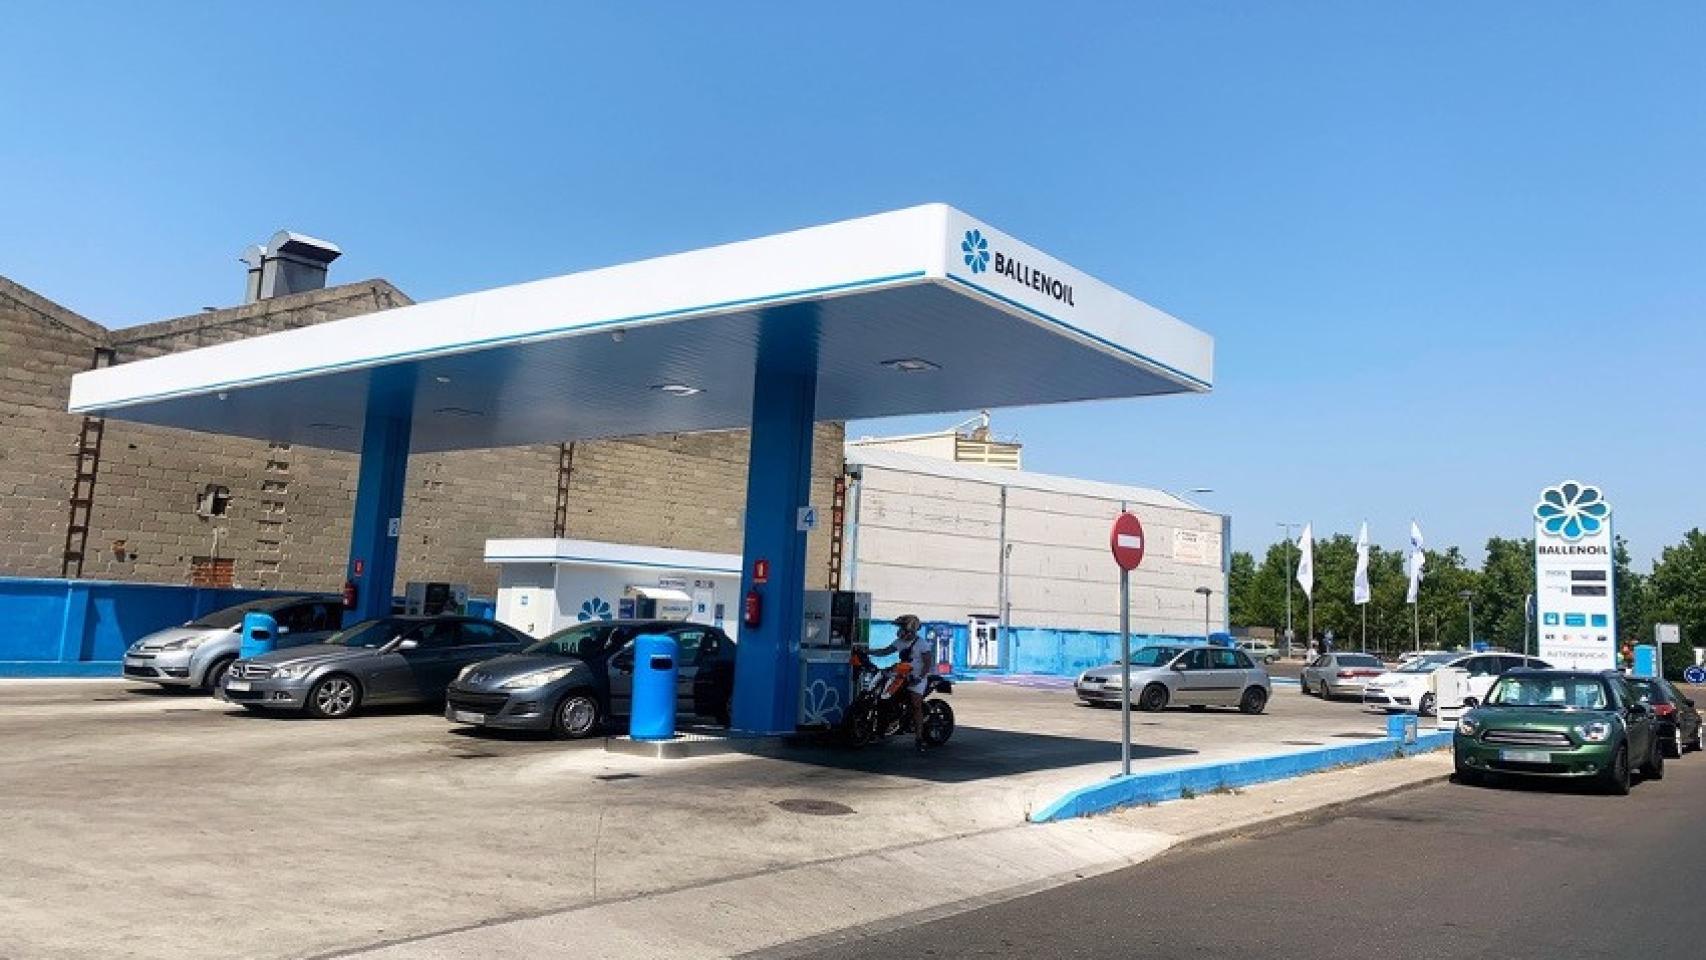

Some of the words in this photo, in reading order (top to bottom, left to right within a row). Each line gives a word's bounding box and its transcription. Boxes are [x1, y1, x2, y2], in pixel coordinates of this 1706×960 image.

[995, 252, 1074, 306] BALLENOIL
[804, 509, 815, 527] 4
[1539, 546, 1608, 554] BALLENOIL
